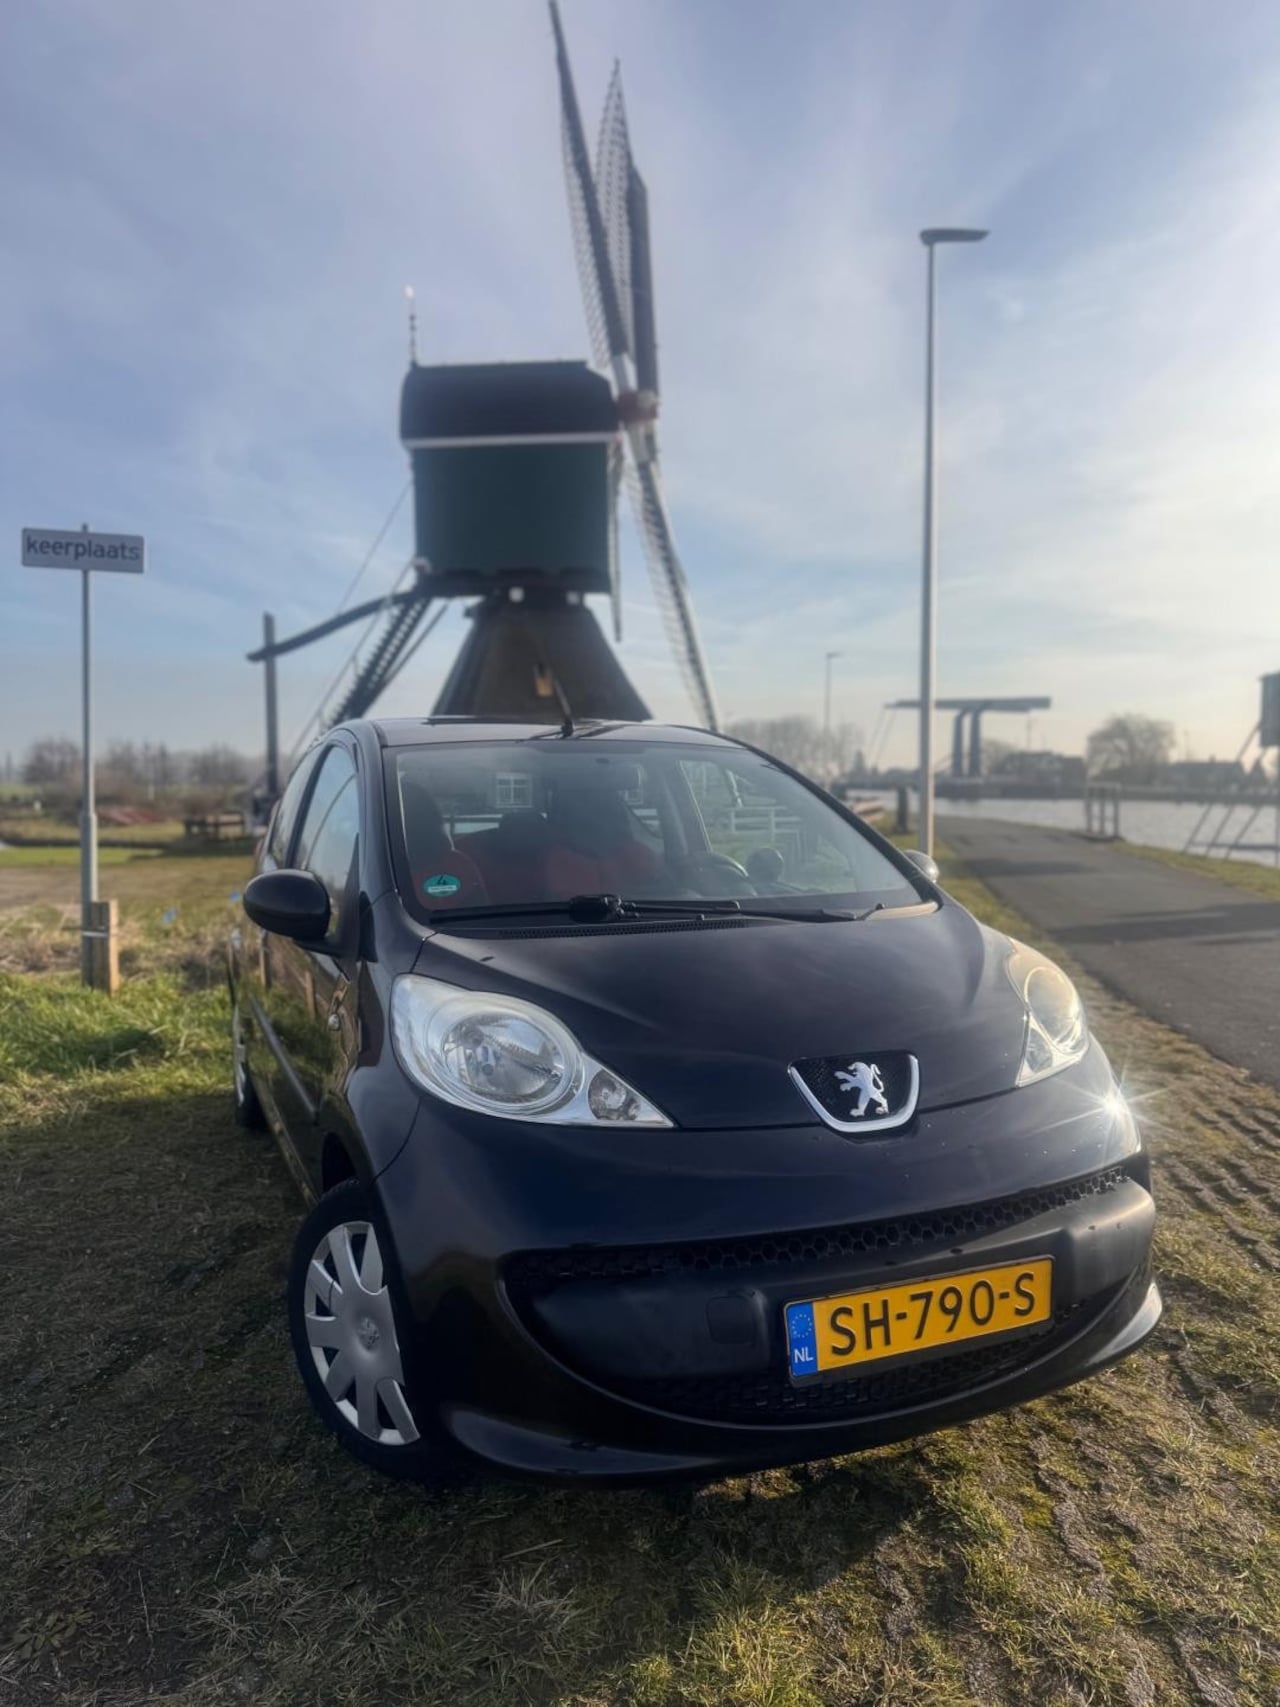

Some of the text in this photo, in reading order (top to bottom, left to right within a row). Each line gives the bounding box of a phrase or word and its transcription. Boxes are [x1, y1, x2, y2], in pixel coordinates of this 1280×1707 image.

[26, 535, 141, 561] keerplaats
[829, 1272, 1035, 1356] SH-790-S
[794, 1346, 814, 1363] NL
